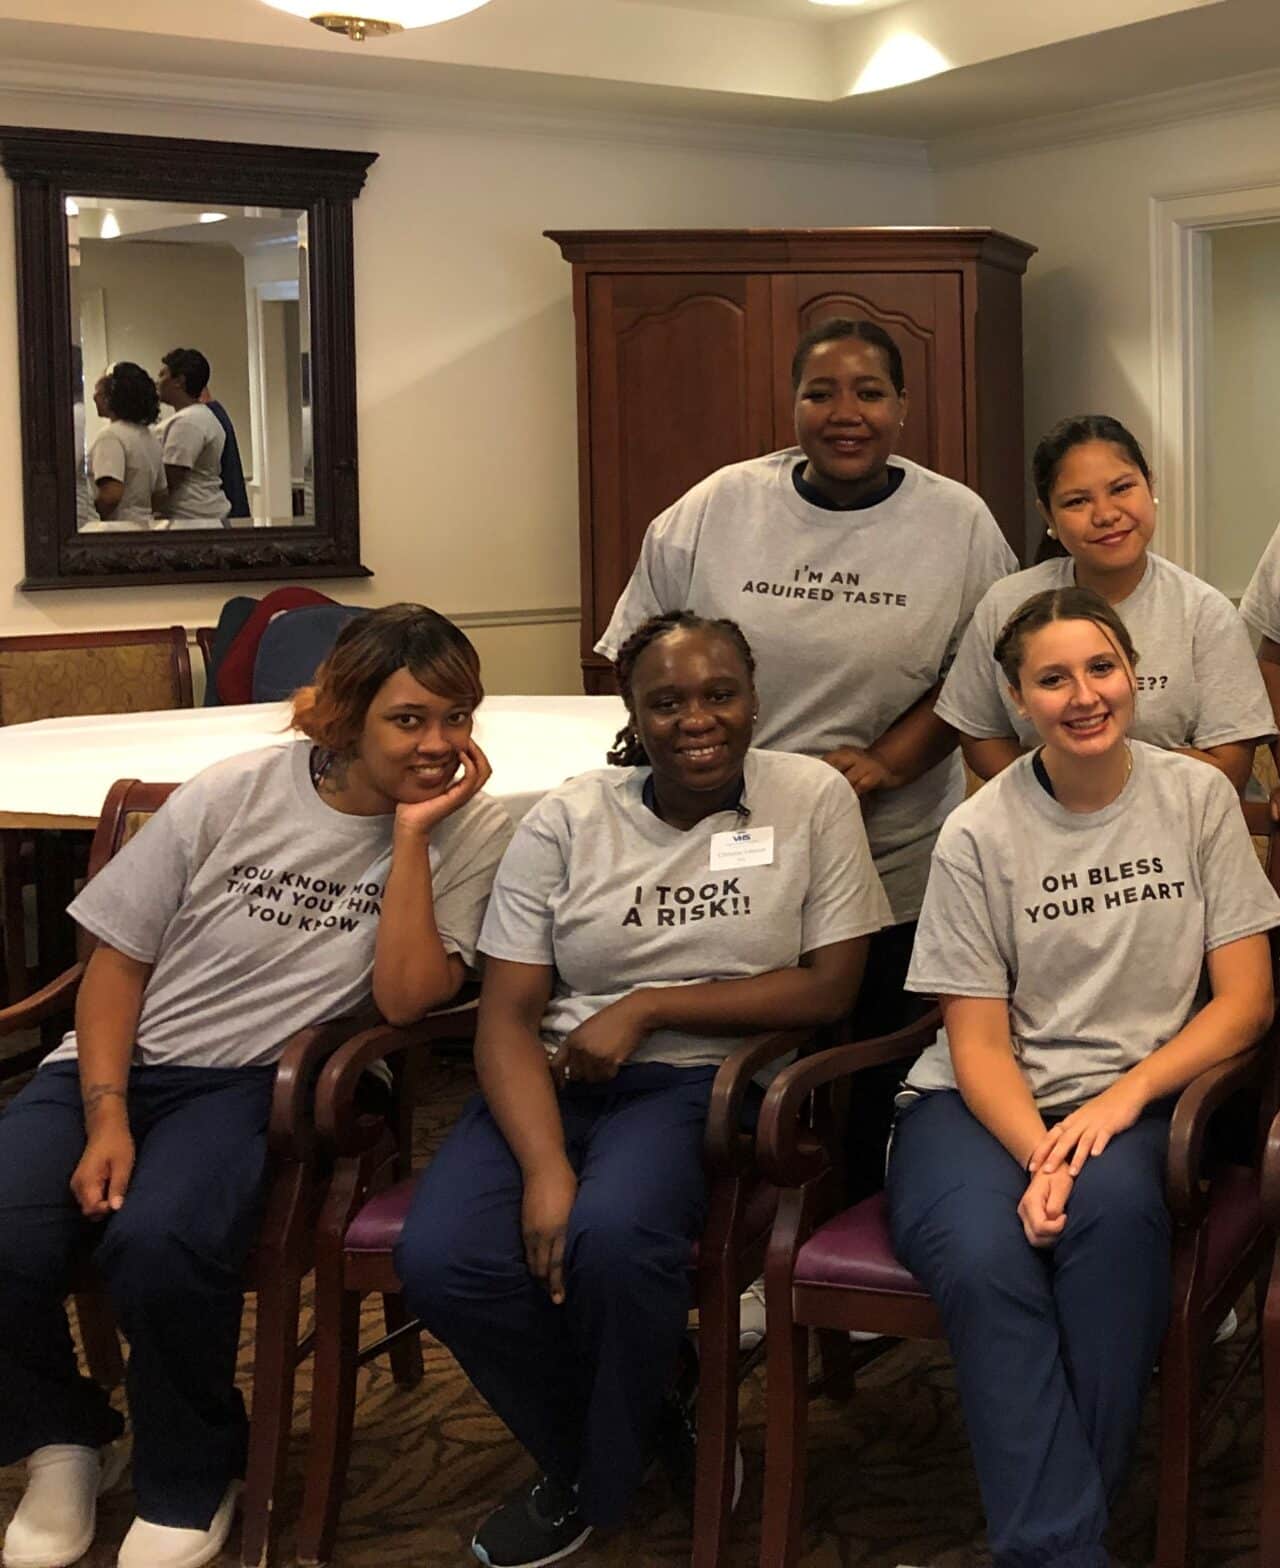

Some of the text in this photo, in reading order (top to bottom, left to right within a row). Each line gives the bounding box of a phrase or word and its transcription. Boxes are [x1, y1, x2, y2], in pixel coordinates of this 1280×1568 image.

[793, 564, 860, 586] I'M AN
[742, 580, 907, 607] AQUIRED TASTE
[232, 864, 274, 881] YOU
[279, 871, 346, 897] KNOW
[1042, 857, 1163, 893] OH BLESS
[226, 879, 283, 902] THAN
[292, 891, 334, 913] YOU
[635, 877, 741, 905] I TOOK
[1025, 881, 1185, 923] YOUR HEART
[248, 903, 292, 926] YOU
[622, 896, 751, 927] A RISK!!
